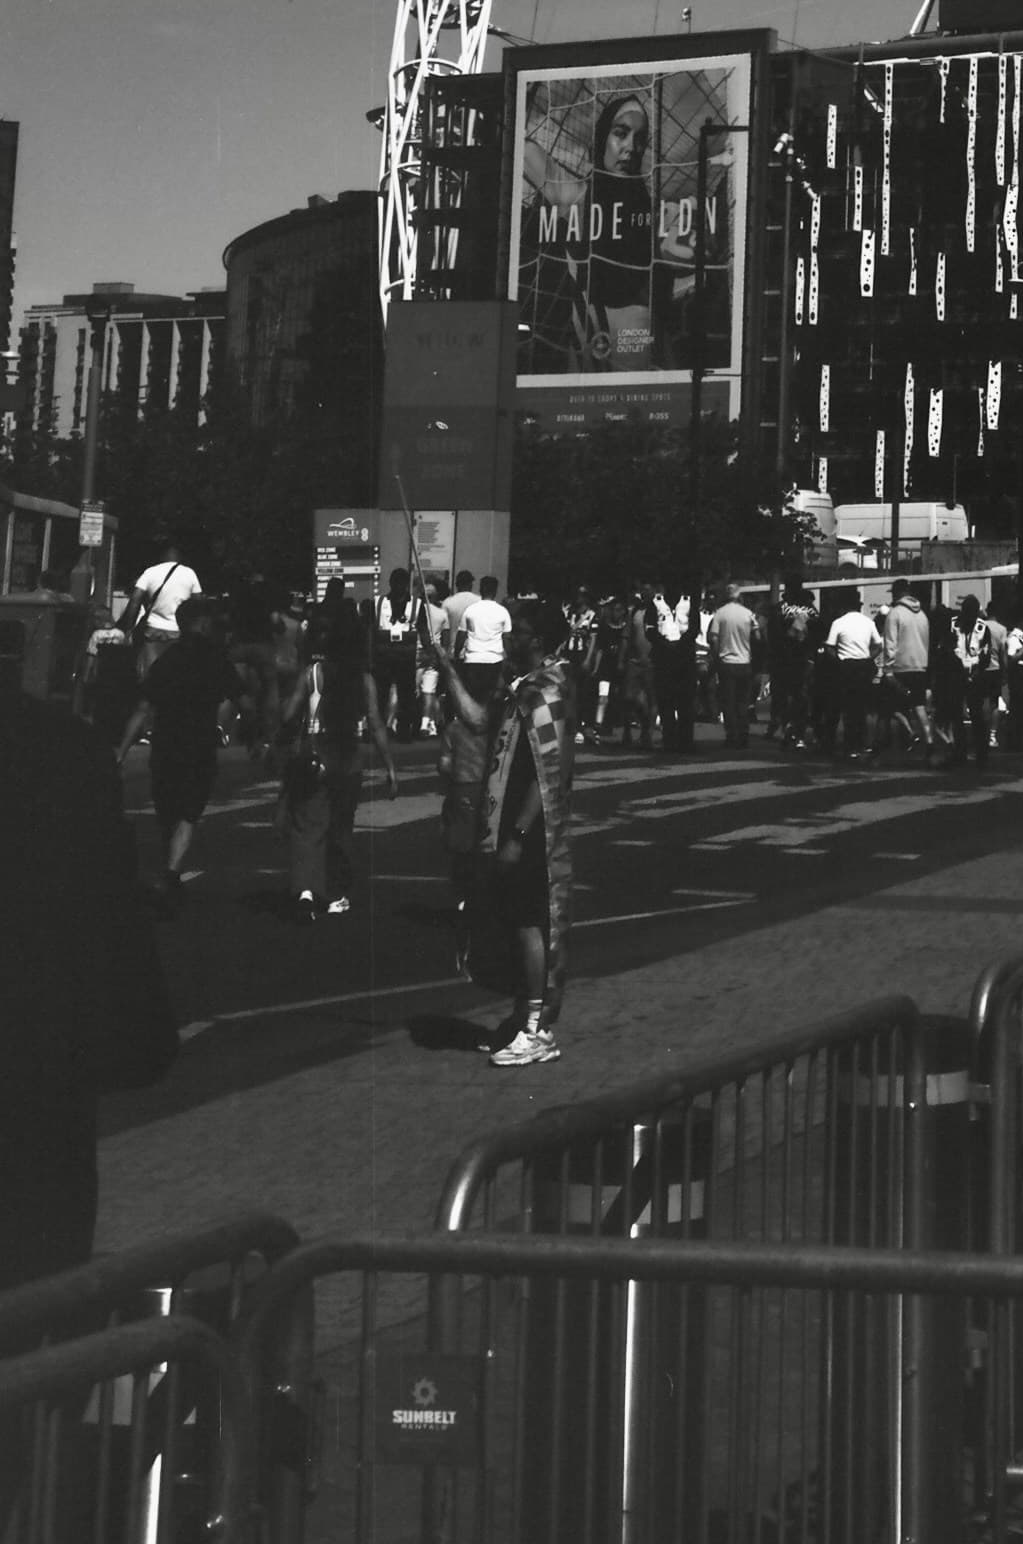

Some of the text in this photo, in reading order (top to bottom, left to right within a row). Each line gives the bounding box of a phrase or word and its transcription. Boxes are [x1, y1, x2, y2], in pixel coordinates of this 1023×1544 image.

[538, 196, 717, 243] MADE FOR LDN
[617, 328, 650, 337] LONDON
[616, 344, 645, 353] OUTLET
[392, 1409, 457, 1424] SUNBELT
